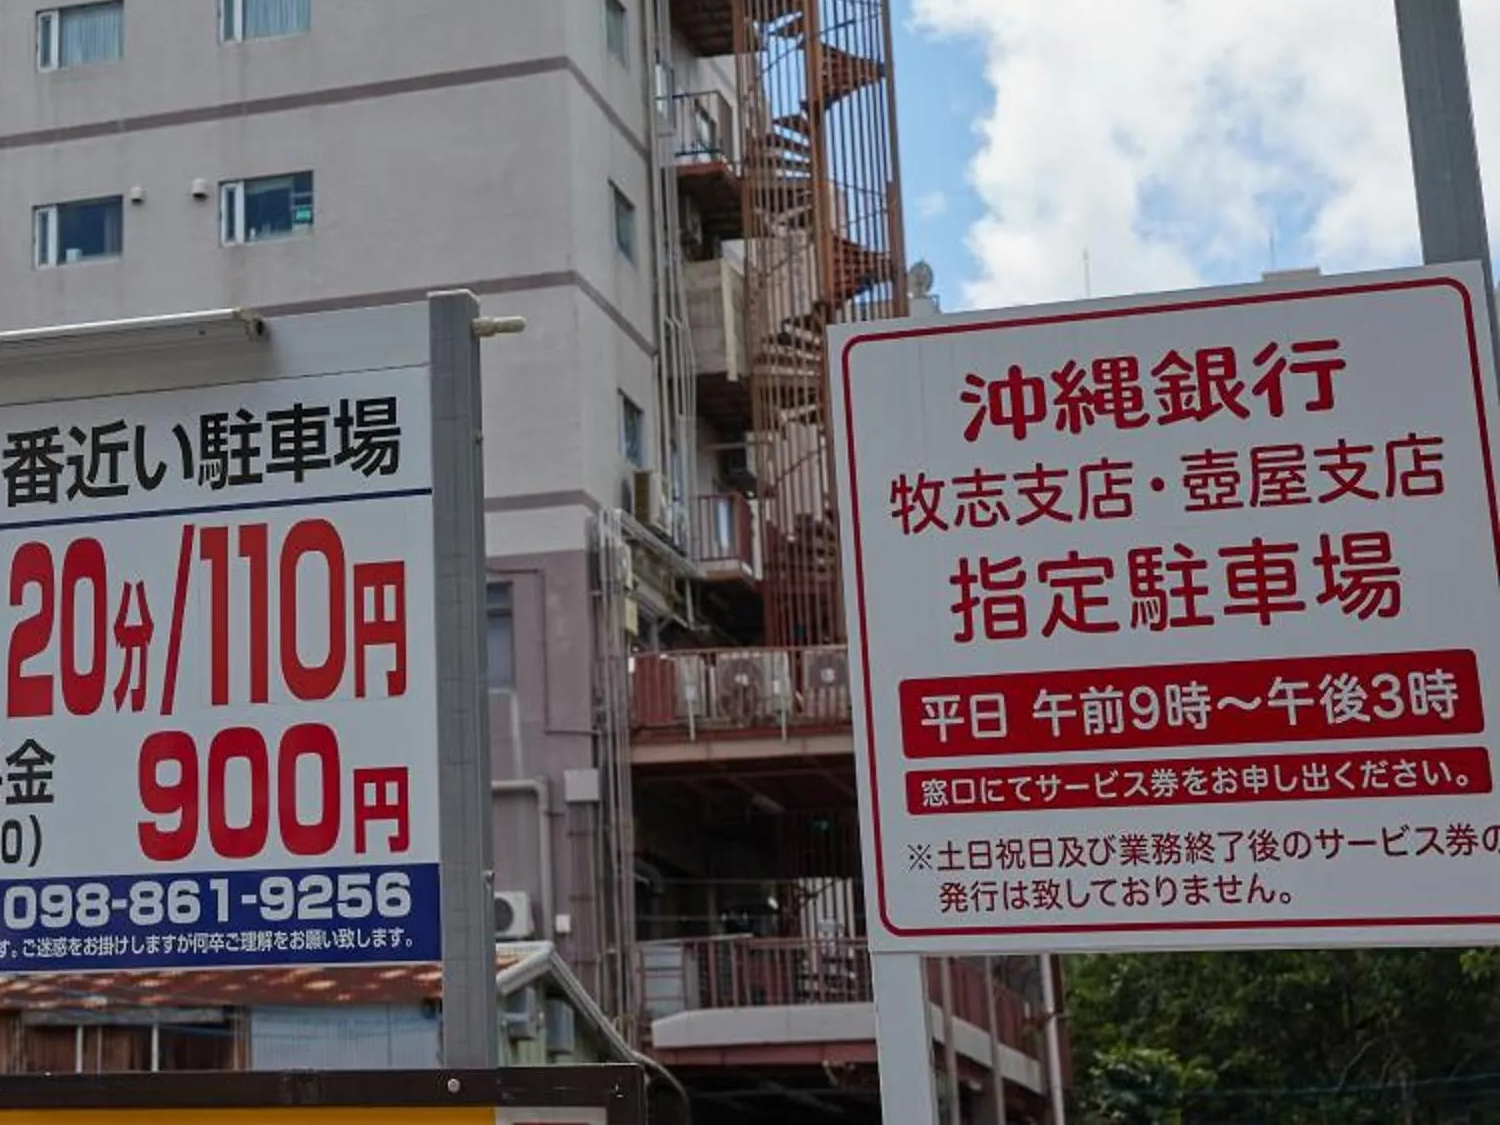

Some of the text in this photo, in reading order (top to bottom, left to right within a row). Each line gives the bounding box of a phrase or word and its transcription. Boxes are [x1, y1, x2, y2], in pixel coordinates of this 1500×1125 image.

[959, 337, 1347, 443] 沖縄銀行
[949, 531, 1402, 643] 指定駐車場
[920, 692, 1008, 743] 平日
[136, 722, 411, 862] 900円
[920, 759, 1470, 807] 窓口にてサービス券をお申し出ください。
[3, 872, 413, 931] 098-861-9256
[940, 874, 1293, 913] 発行は致しておりません。
